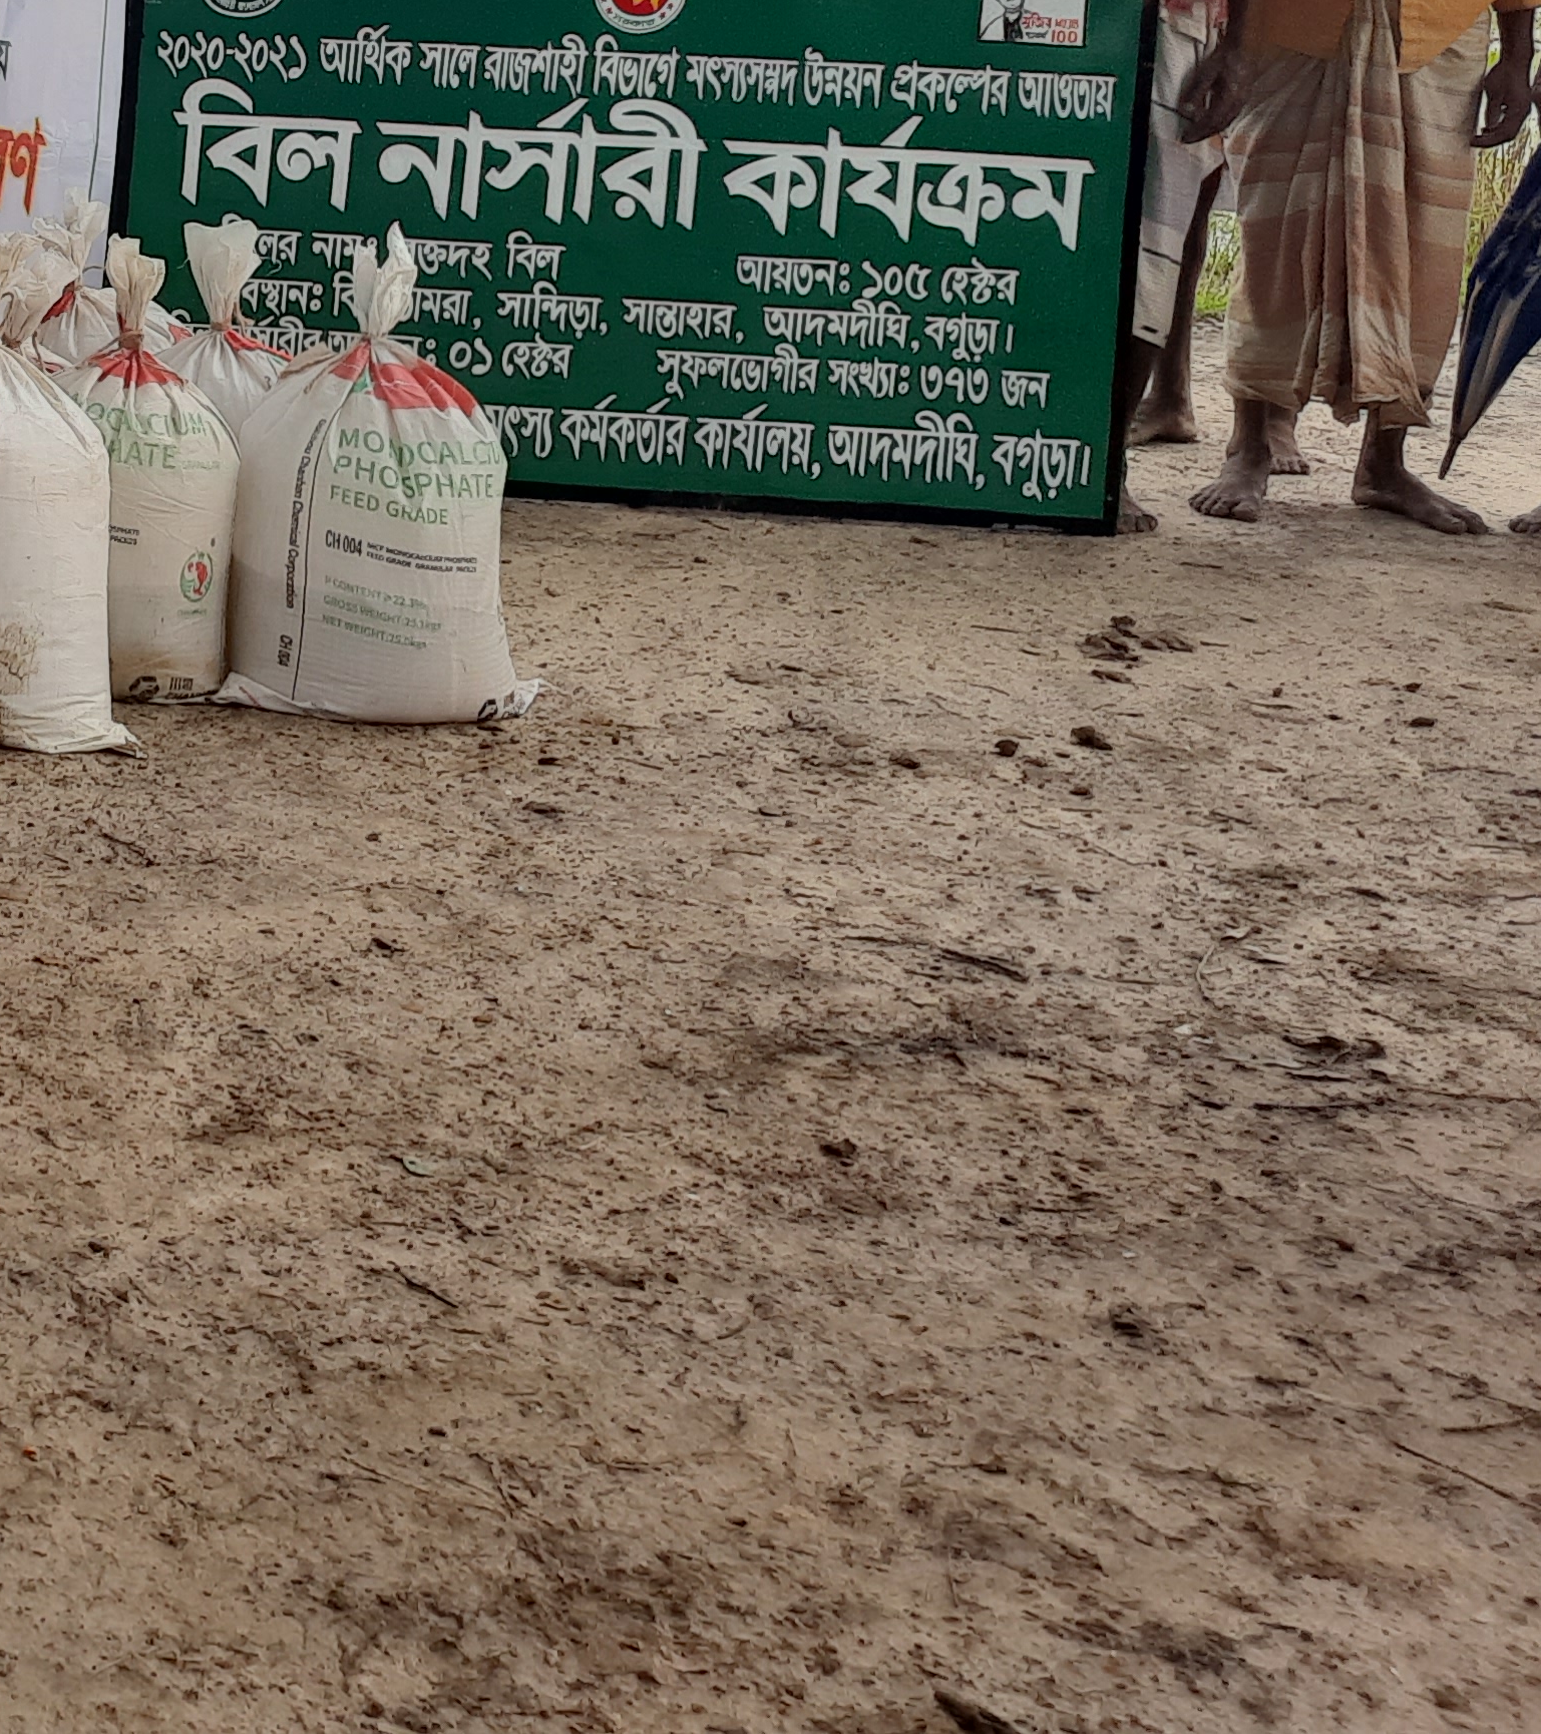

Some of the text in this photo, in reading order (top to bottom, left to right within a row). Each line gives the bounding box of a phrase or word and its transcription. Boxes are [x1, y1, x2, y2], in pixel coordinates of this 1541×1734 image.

[1051, 30, 1078, 43] 100
[157, 30, 307, 84] ২০২০-২০২১
[320, 25, 413, 86] আর্থিক
[417, 41, 481, 90] সালে
[484, 33, 588, 98] রাজশাহী
[592, 33, 680, 99] বিভাগে
[803, 46, 885, 109] উন্নয়ন
[892, 59, 1012, 117] প্রকল্পের
[1018, 71, 1117, 122] আওতায়
[172, 77, 1095, 252] বিল নার্সারী কার্যক্রম
[506, 230, 566, 281] বিল
[861, 261, 933, 301] ১০৫
[940, 257, 1019, 306] হেক্টর
[242, 278, 324, 316] বস্থানঃ
[622, 297, 745, 344] সান্তাহার,
[763, 298, 920, 354] আদমদীঘি,
[449, 332, 573, 379] ০১ হেক্টর
[656, 342, 819, 399] সুফলভোগীর
[920, 365, 989, 405] ৩৭৩
[1000, 369, 1050, 409] জন
[560, 394, 689, 466] কর্মকর্তার
[694, 403, 821, 479] কার্যালয়,
[827, 409, 986, 490] আদমদীঘি,
[333, 455, 494, 500] PHOSPHATE
[329, 484, 449, 526] FEED GRADE
[325, 529, 363, 557] CH 004
[279, 634, 294, 650] CH
